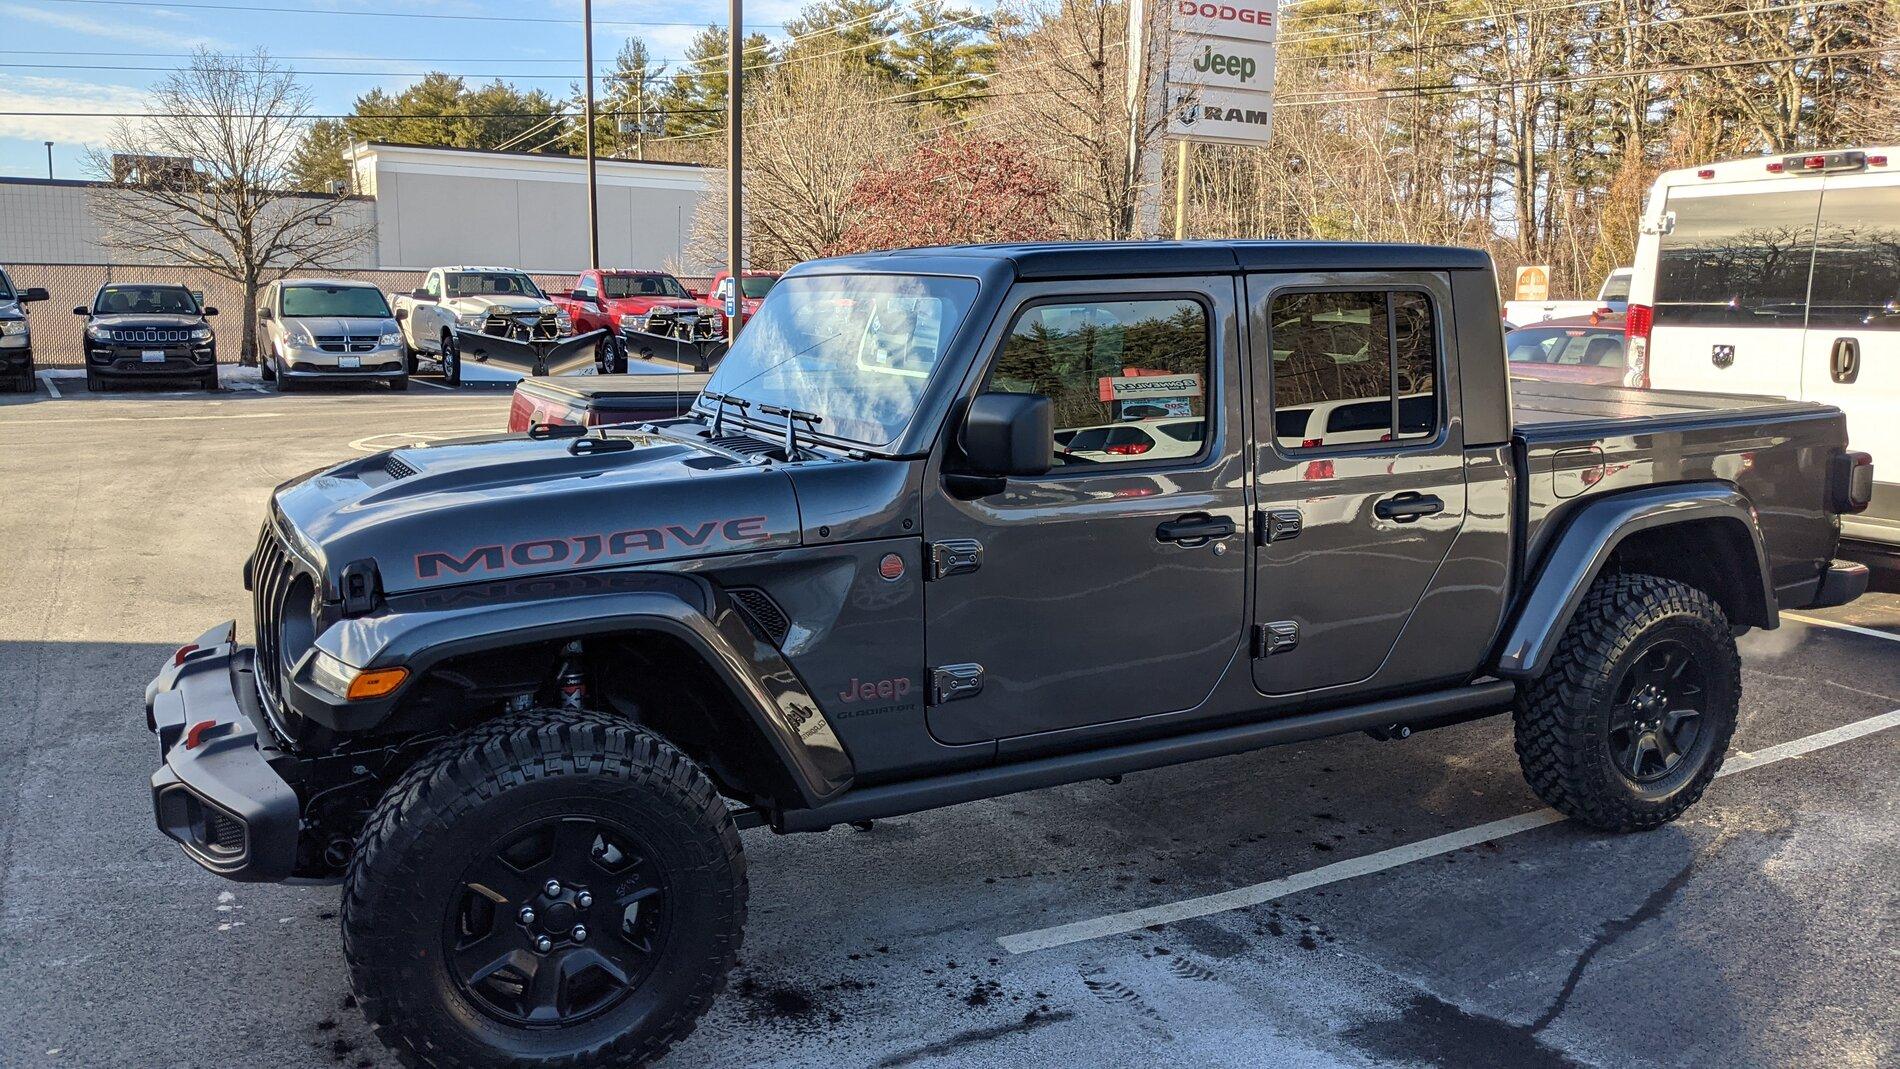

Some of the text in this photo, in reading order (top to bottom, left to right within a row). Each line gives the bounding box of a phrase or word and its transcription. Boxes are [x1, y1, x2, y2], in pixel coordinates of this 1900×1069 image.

[1178, 2, 1272, 26] DODGE
[1194, 45, 1256, 82] Jeep
[1204, 106, 1268, 125] RAM
[414, 516, 771, 579] MOJAVE
[839, 678, 911, 703] Jeep
[837, 704, 915, 720] GLADIATOR
